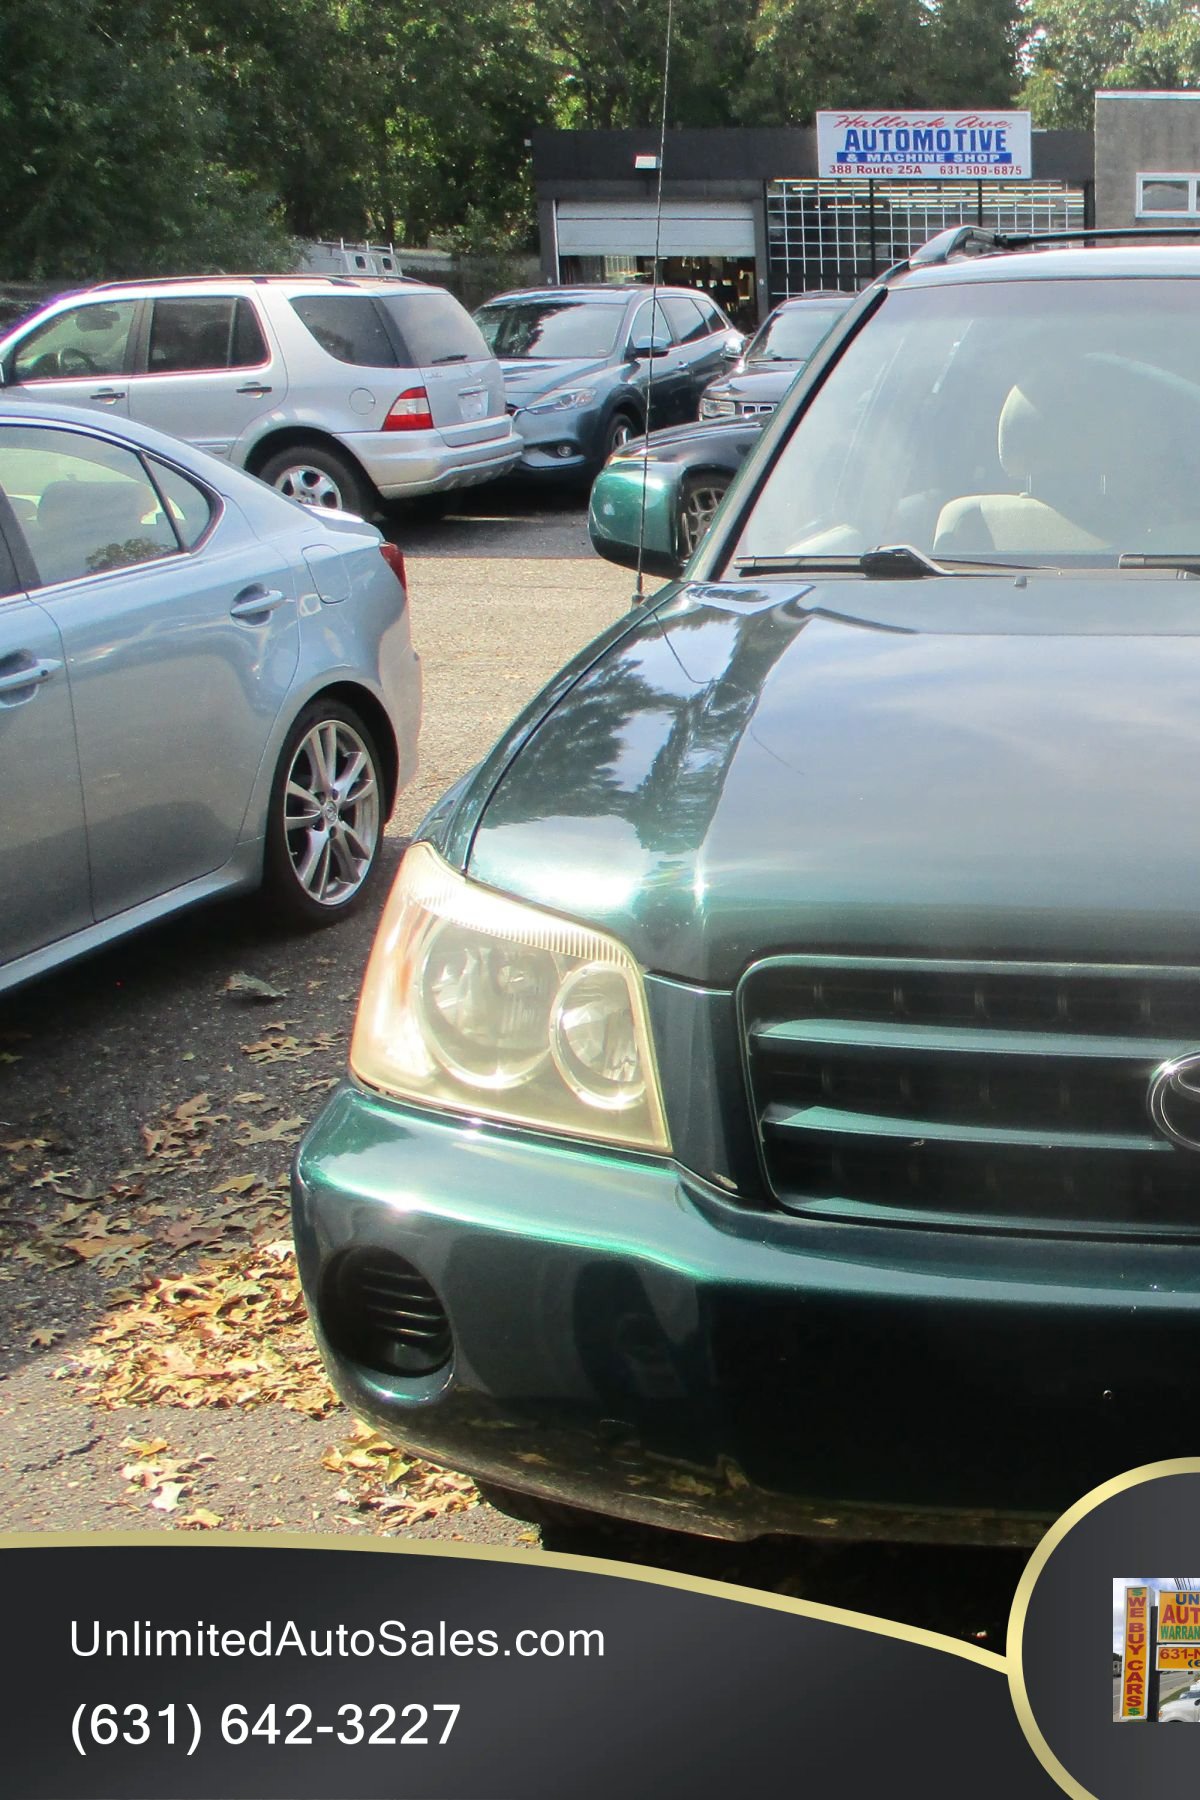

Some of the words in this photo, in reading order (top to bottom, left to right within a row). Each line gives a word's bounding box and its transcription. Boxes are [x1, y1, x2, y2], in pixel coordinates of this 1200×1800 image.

[833, 114, 946, 129] Hallock
[955, 115, 1013, 130] Ave.
[844, 129, 1007, 152] AUTOMOTIVE
[846, 154, 857, 163] &
[867, 153, 945, 163] MACHINE
[953, 153, 1000, 163] SHOP
[829, 165, 851, 174] 388
[856, 165, 893, 174] Route
[899, 165, 922, 174] 25A
[939, 165, 1022, 175] 631-509-6875
